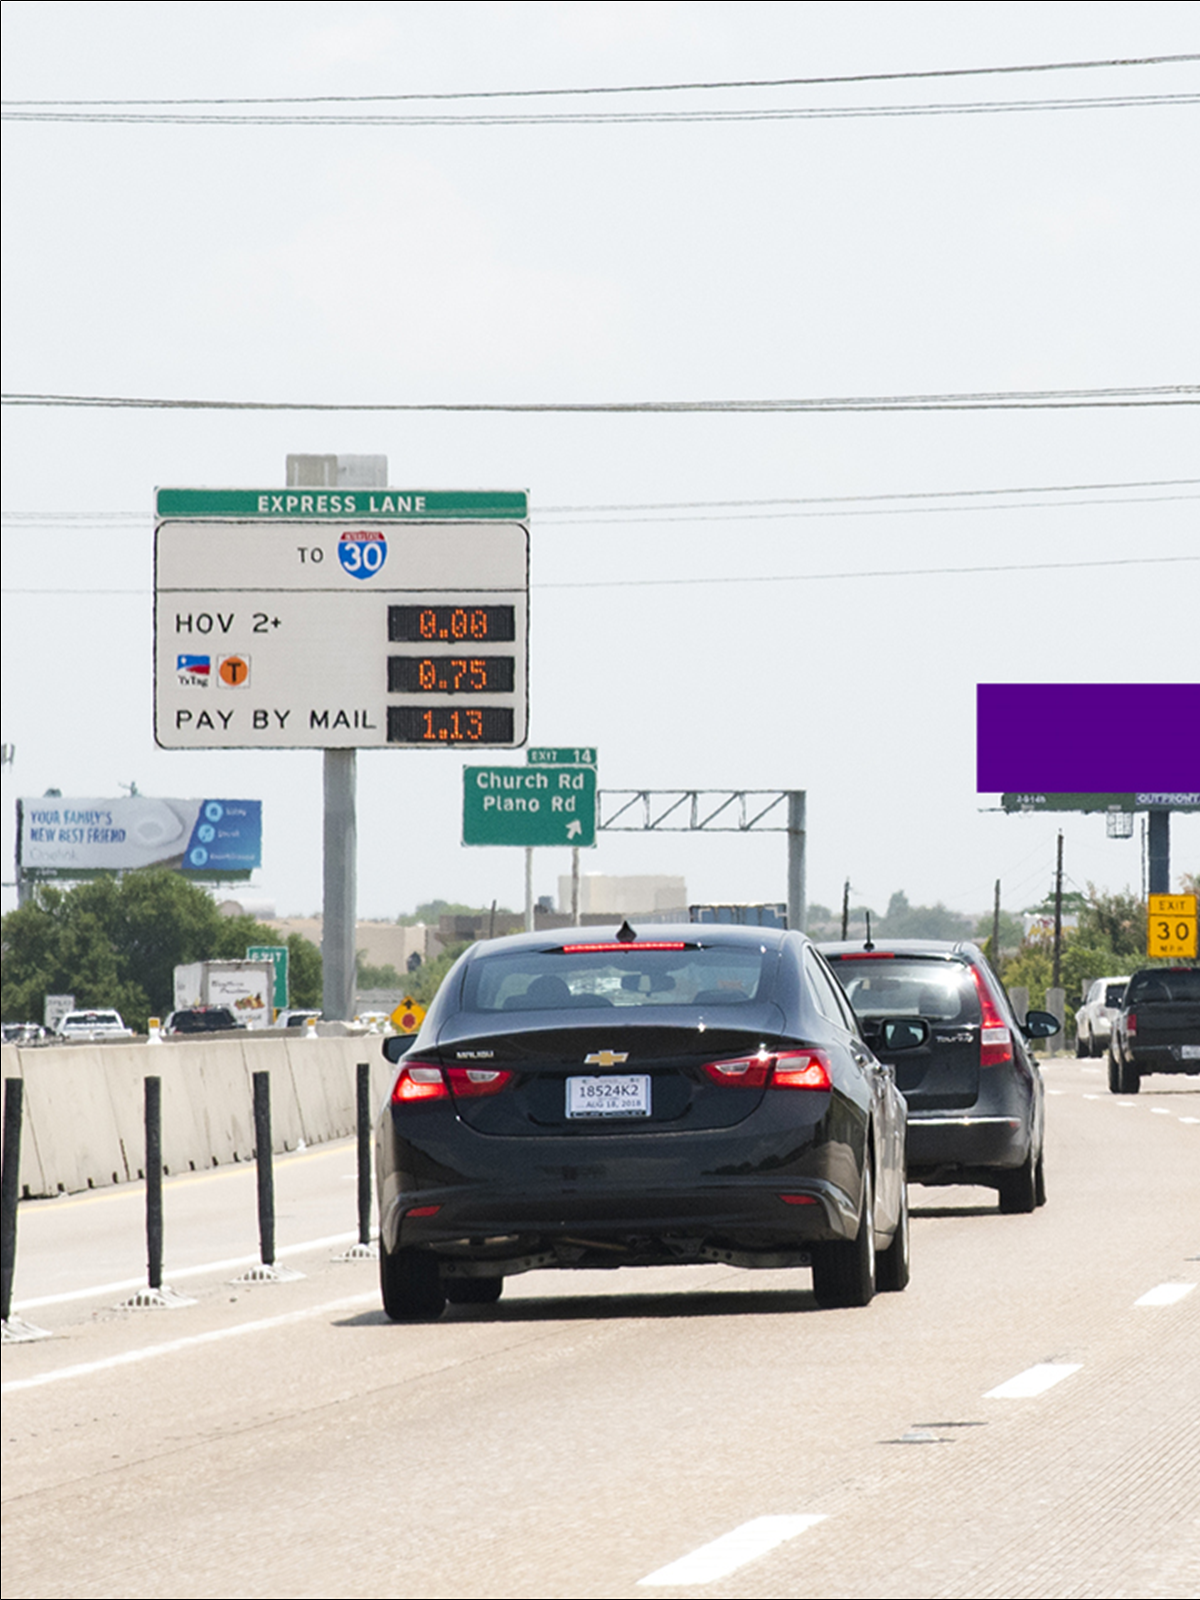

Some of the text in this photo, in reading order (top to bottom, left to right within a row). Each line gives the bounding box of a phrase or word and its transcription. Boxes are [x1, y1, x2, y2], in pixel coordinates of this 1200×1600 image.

[258, 495, 427, 513] EXPRESS LANE
[297, 547, 324, 563] TO
[343, 542, 382, 571] 30
[175, 612, 282, 634] HOV 2+
[420, 609, 487, 638] 0.00
[226, 661, 242, 683] T
[420, 659, 487, 689] 0.75
[176, 709, 377, 730] PAY BY MAIL
[423, 710, 482, 739] 1.13
[531, 749, 592, 763] EXIT 14
[476, 771, 584, 790] Church Rd
[483, 795, 576, 812] Plano Rd
[30, 809, 113, 826] YOUR FAMILY'S
[30, 827, 126, 844] NEW BEST FRIEND
[1159, 900, 1186, 911] EXIT
[1157, 921, 1190, 942] 30
[579, 1084, 640, 1099] 18524K2
